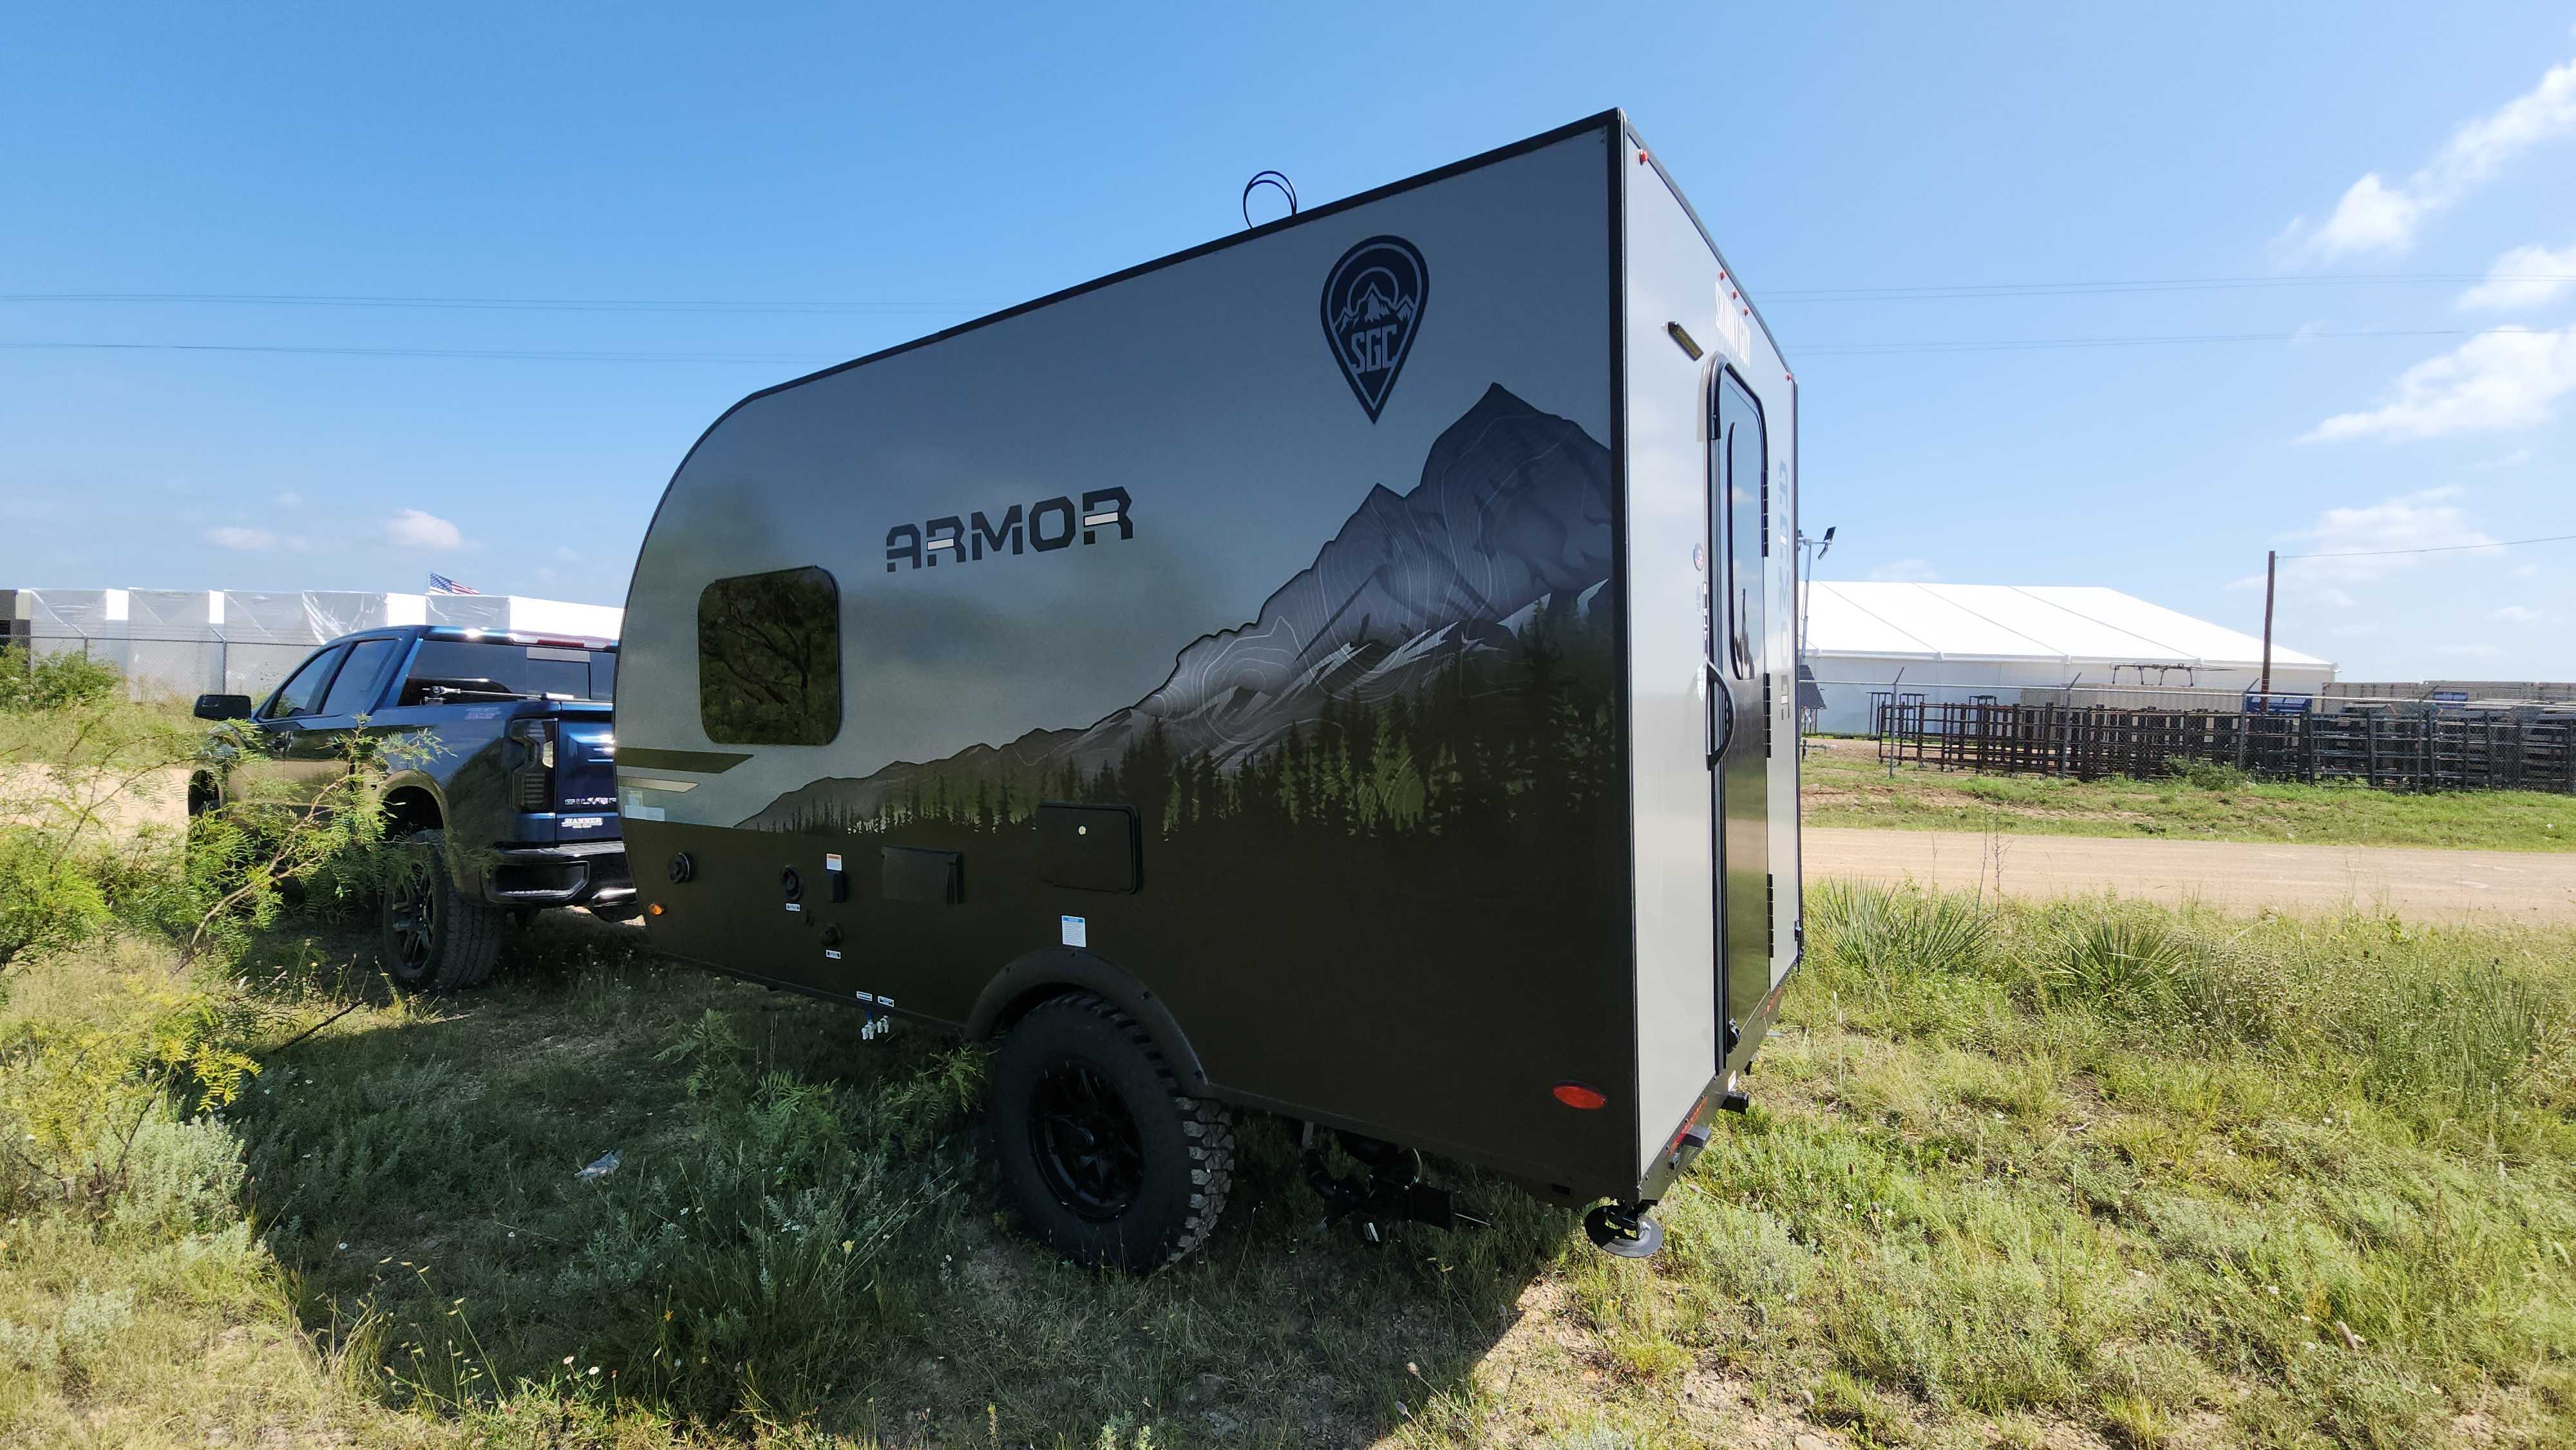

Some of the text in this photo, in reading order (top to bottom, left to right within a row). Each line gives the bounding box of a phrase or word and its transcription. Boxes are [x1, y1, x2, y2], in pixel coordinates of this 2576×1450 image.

[1351, 324, 1397, 374] SGC
[1716, 281, 1750, 368] SKINNY GUY
[886, 486, 1133, 572] ARMOR
